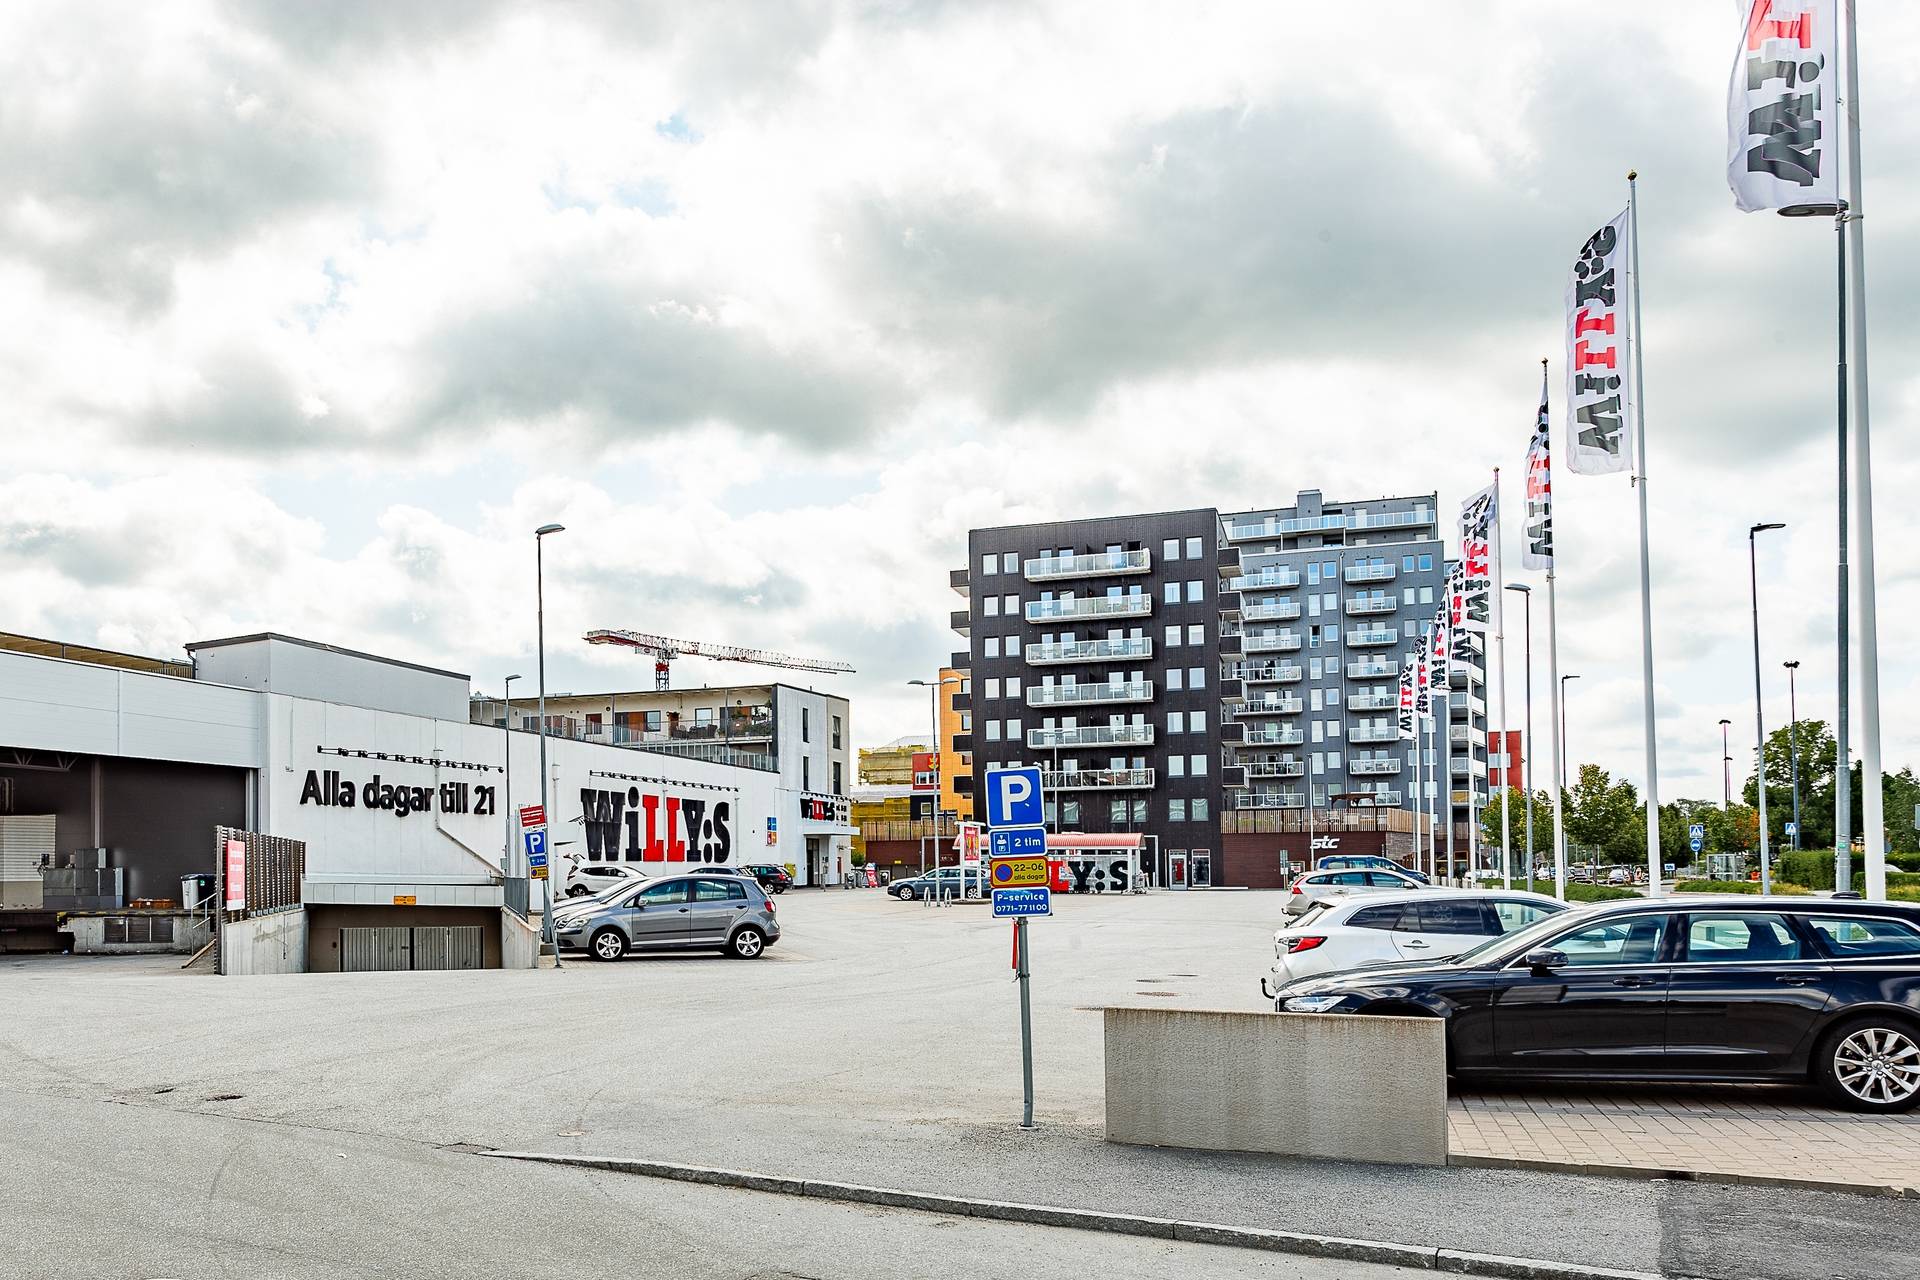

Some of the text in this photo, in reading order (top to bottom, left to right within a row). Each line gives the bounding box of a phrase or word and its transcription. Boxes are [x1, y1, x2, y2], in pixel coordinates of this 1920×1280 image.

[300, 770, 495, 817] Alla dagar till 21
[1001, 775, 1032, 820] P
[530, 834, 541, 853] P
[1014, 837, 1041, 847] 2 tim
[1310, 835, 1340, 849] stc
[1014, 862, 1044, 872] 22-06
[1048, 860, 1129, 892] LY:S
[997, 893, 1045, 901] P-service
